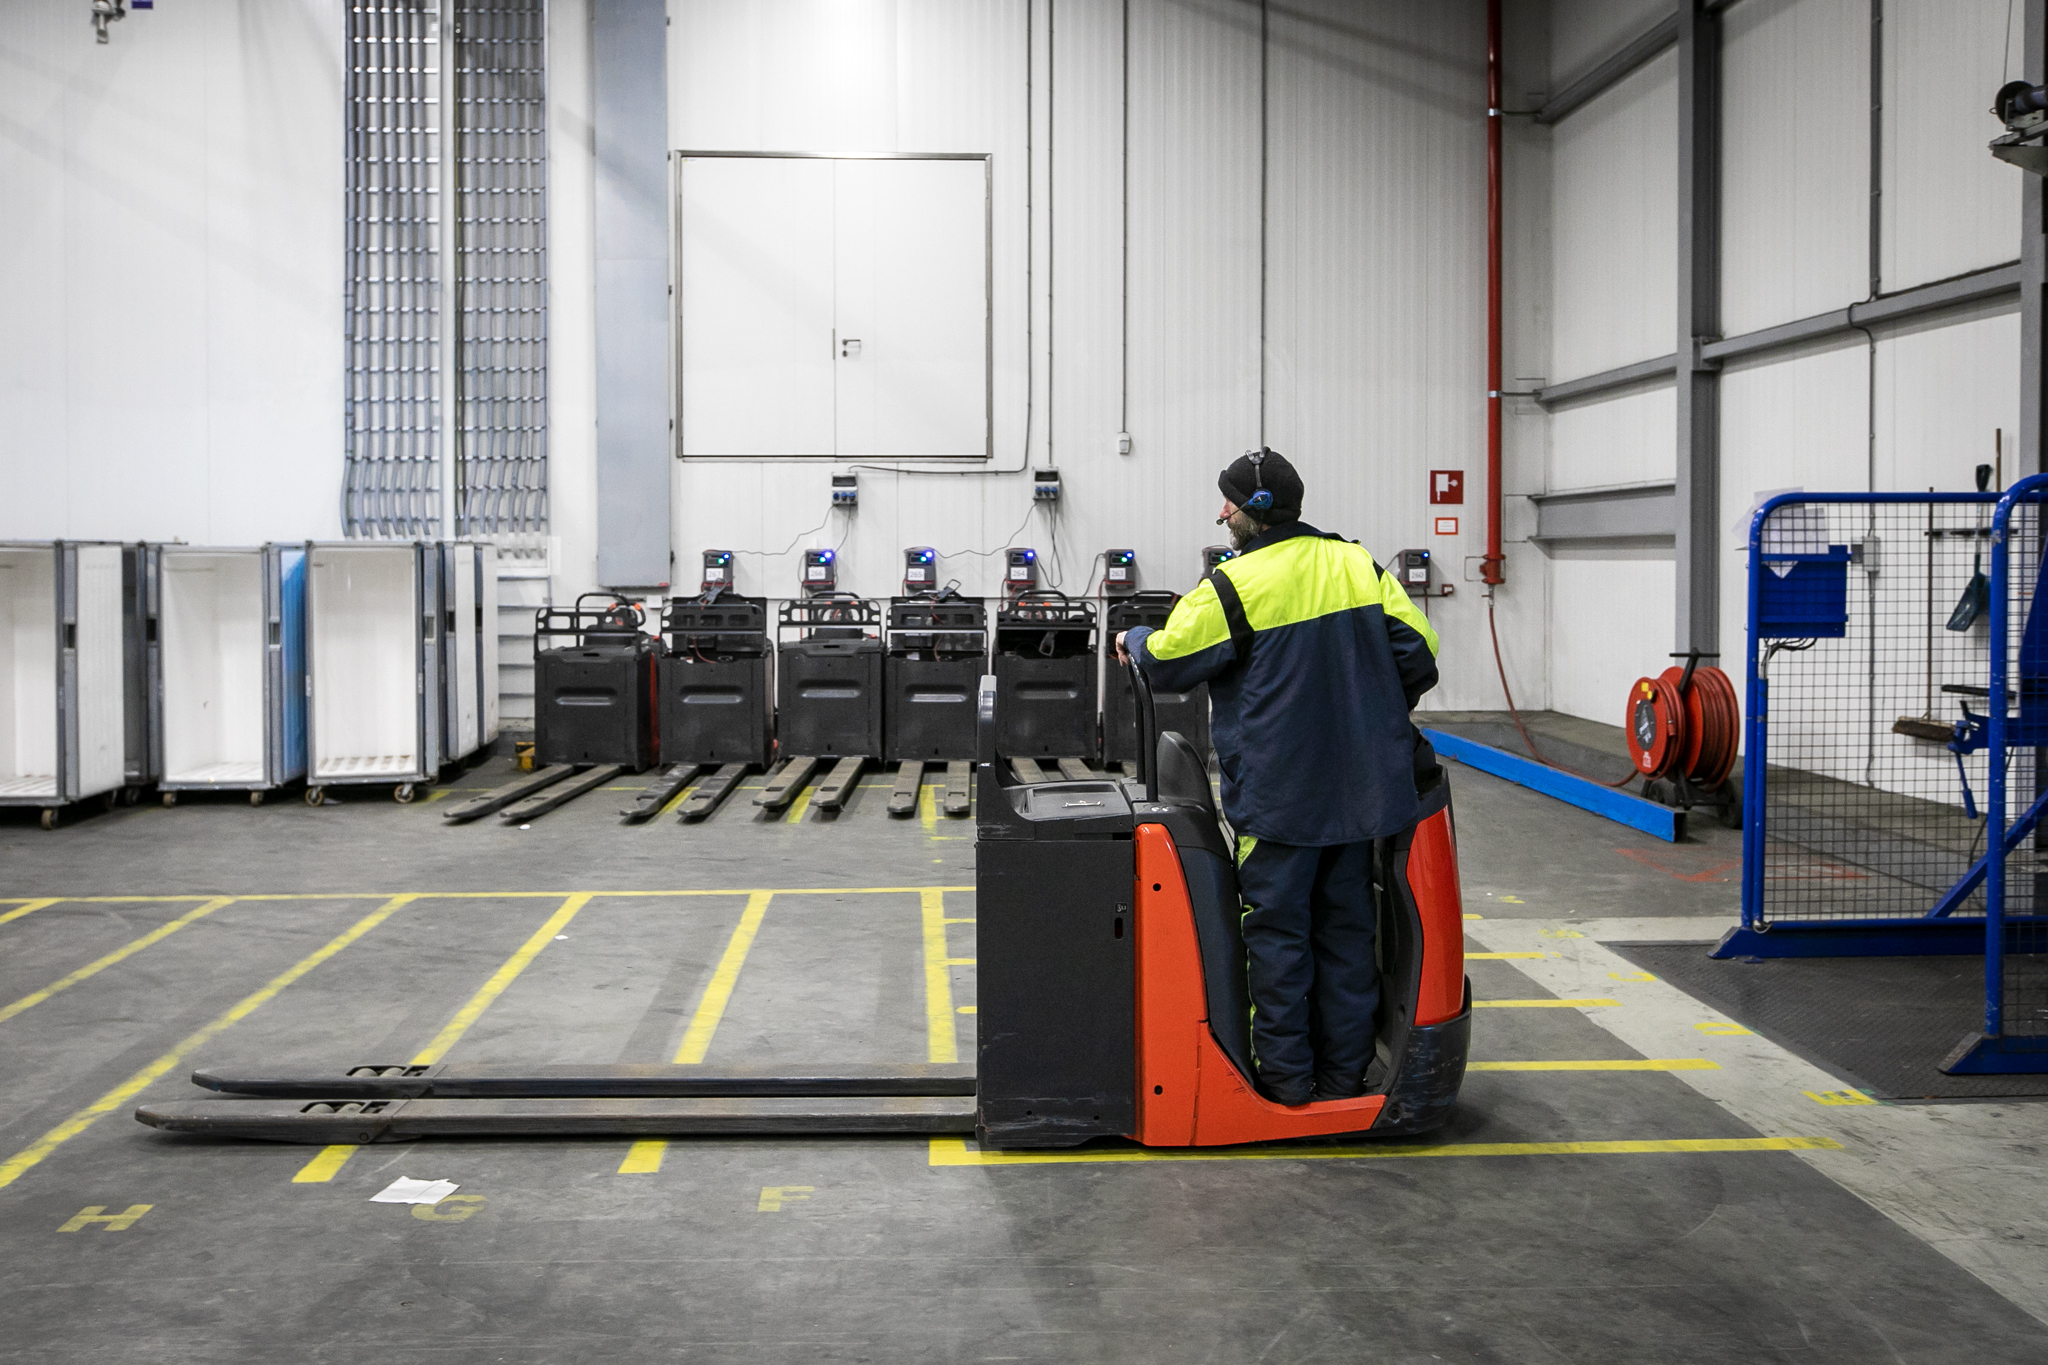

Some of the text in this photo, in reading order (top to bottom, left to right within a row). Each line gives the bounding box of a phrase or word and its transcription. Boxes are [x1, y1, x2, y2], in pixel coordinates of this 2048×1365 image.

[708, 570, 721, 578] 267
[810, 569, 823, 577] 266
[909, 570, 923, 578] 265
[1012, 569, 1025, 577] 264
[1111, 569, 1124, 577] 263
[1411, 571, 1424, 579] 260
[757, 1185, 815, 1212] F
[410, 1194, 487, 1222] G
[56, 1203, 154, 1232] H
